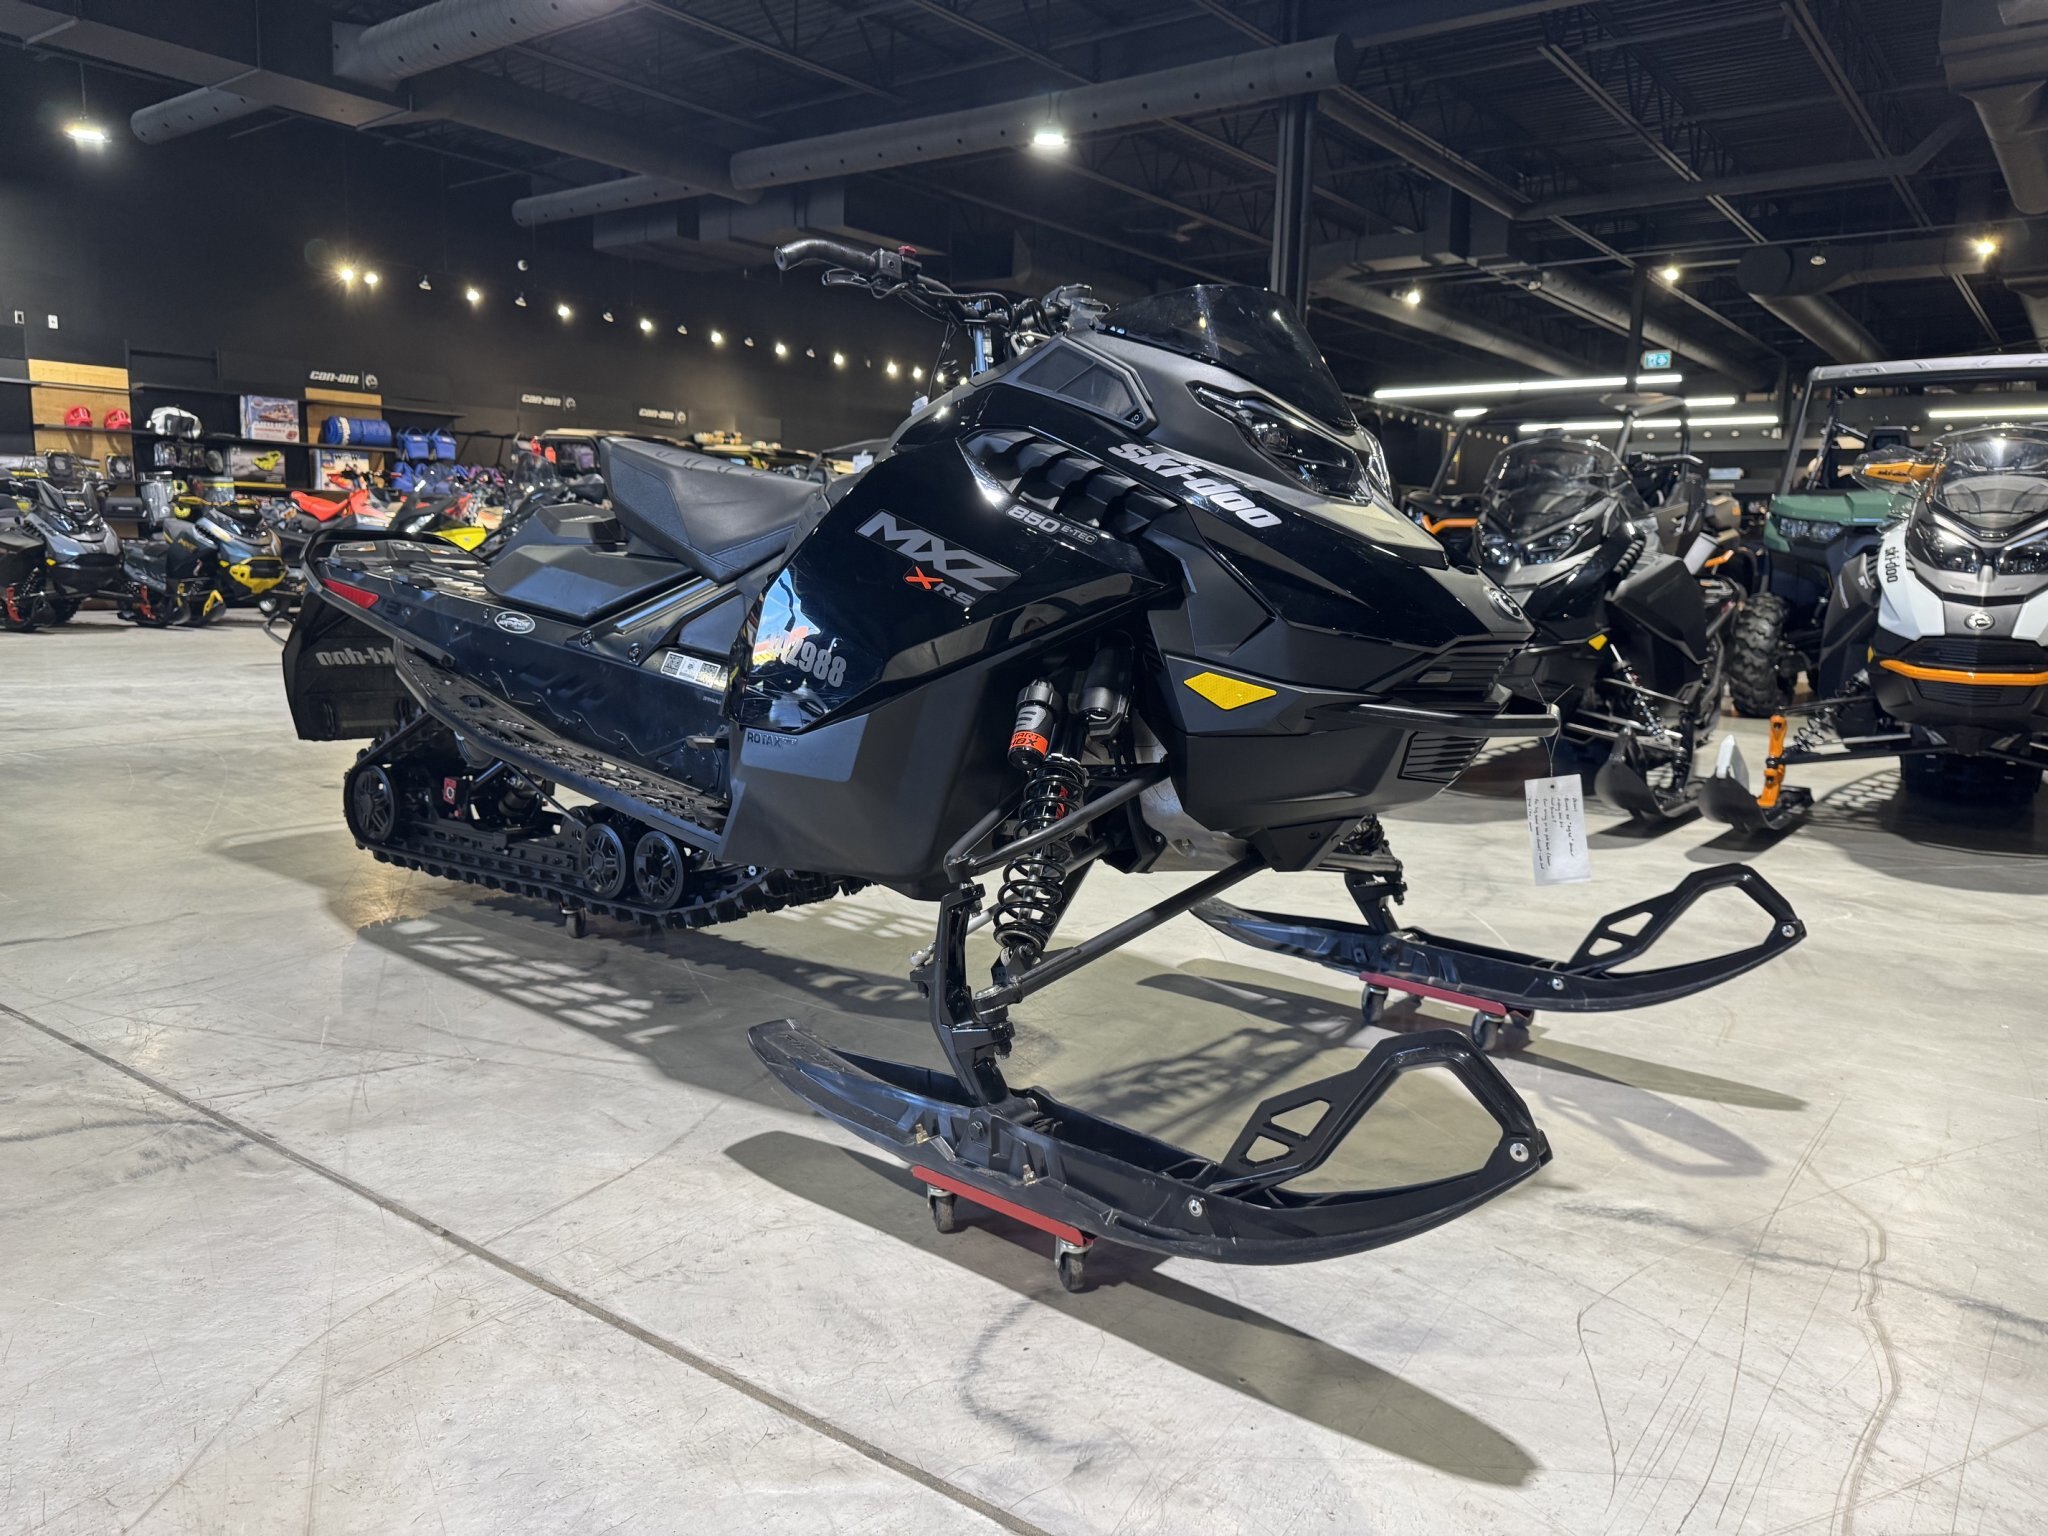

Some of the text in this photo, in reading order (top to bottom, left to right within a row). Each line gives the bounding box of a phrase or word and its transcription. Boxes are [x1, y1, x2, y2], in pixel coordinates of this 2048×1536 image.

[310, 370, 360, 385] can-am
[521, 393, 561, 406] can-am
[639, 407, 674, 420] can-am
[1007, 505, 1096, 544] 850 E-TEC
[857, 511, 1020, 591] MXZ
[1884, 546, 1899, 584] ski-doo
[747, 731, 782, 748] ROTAX
